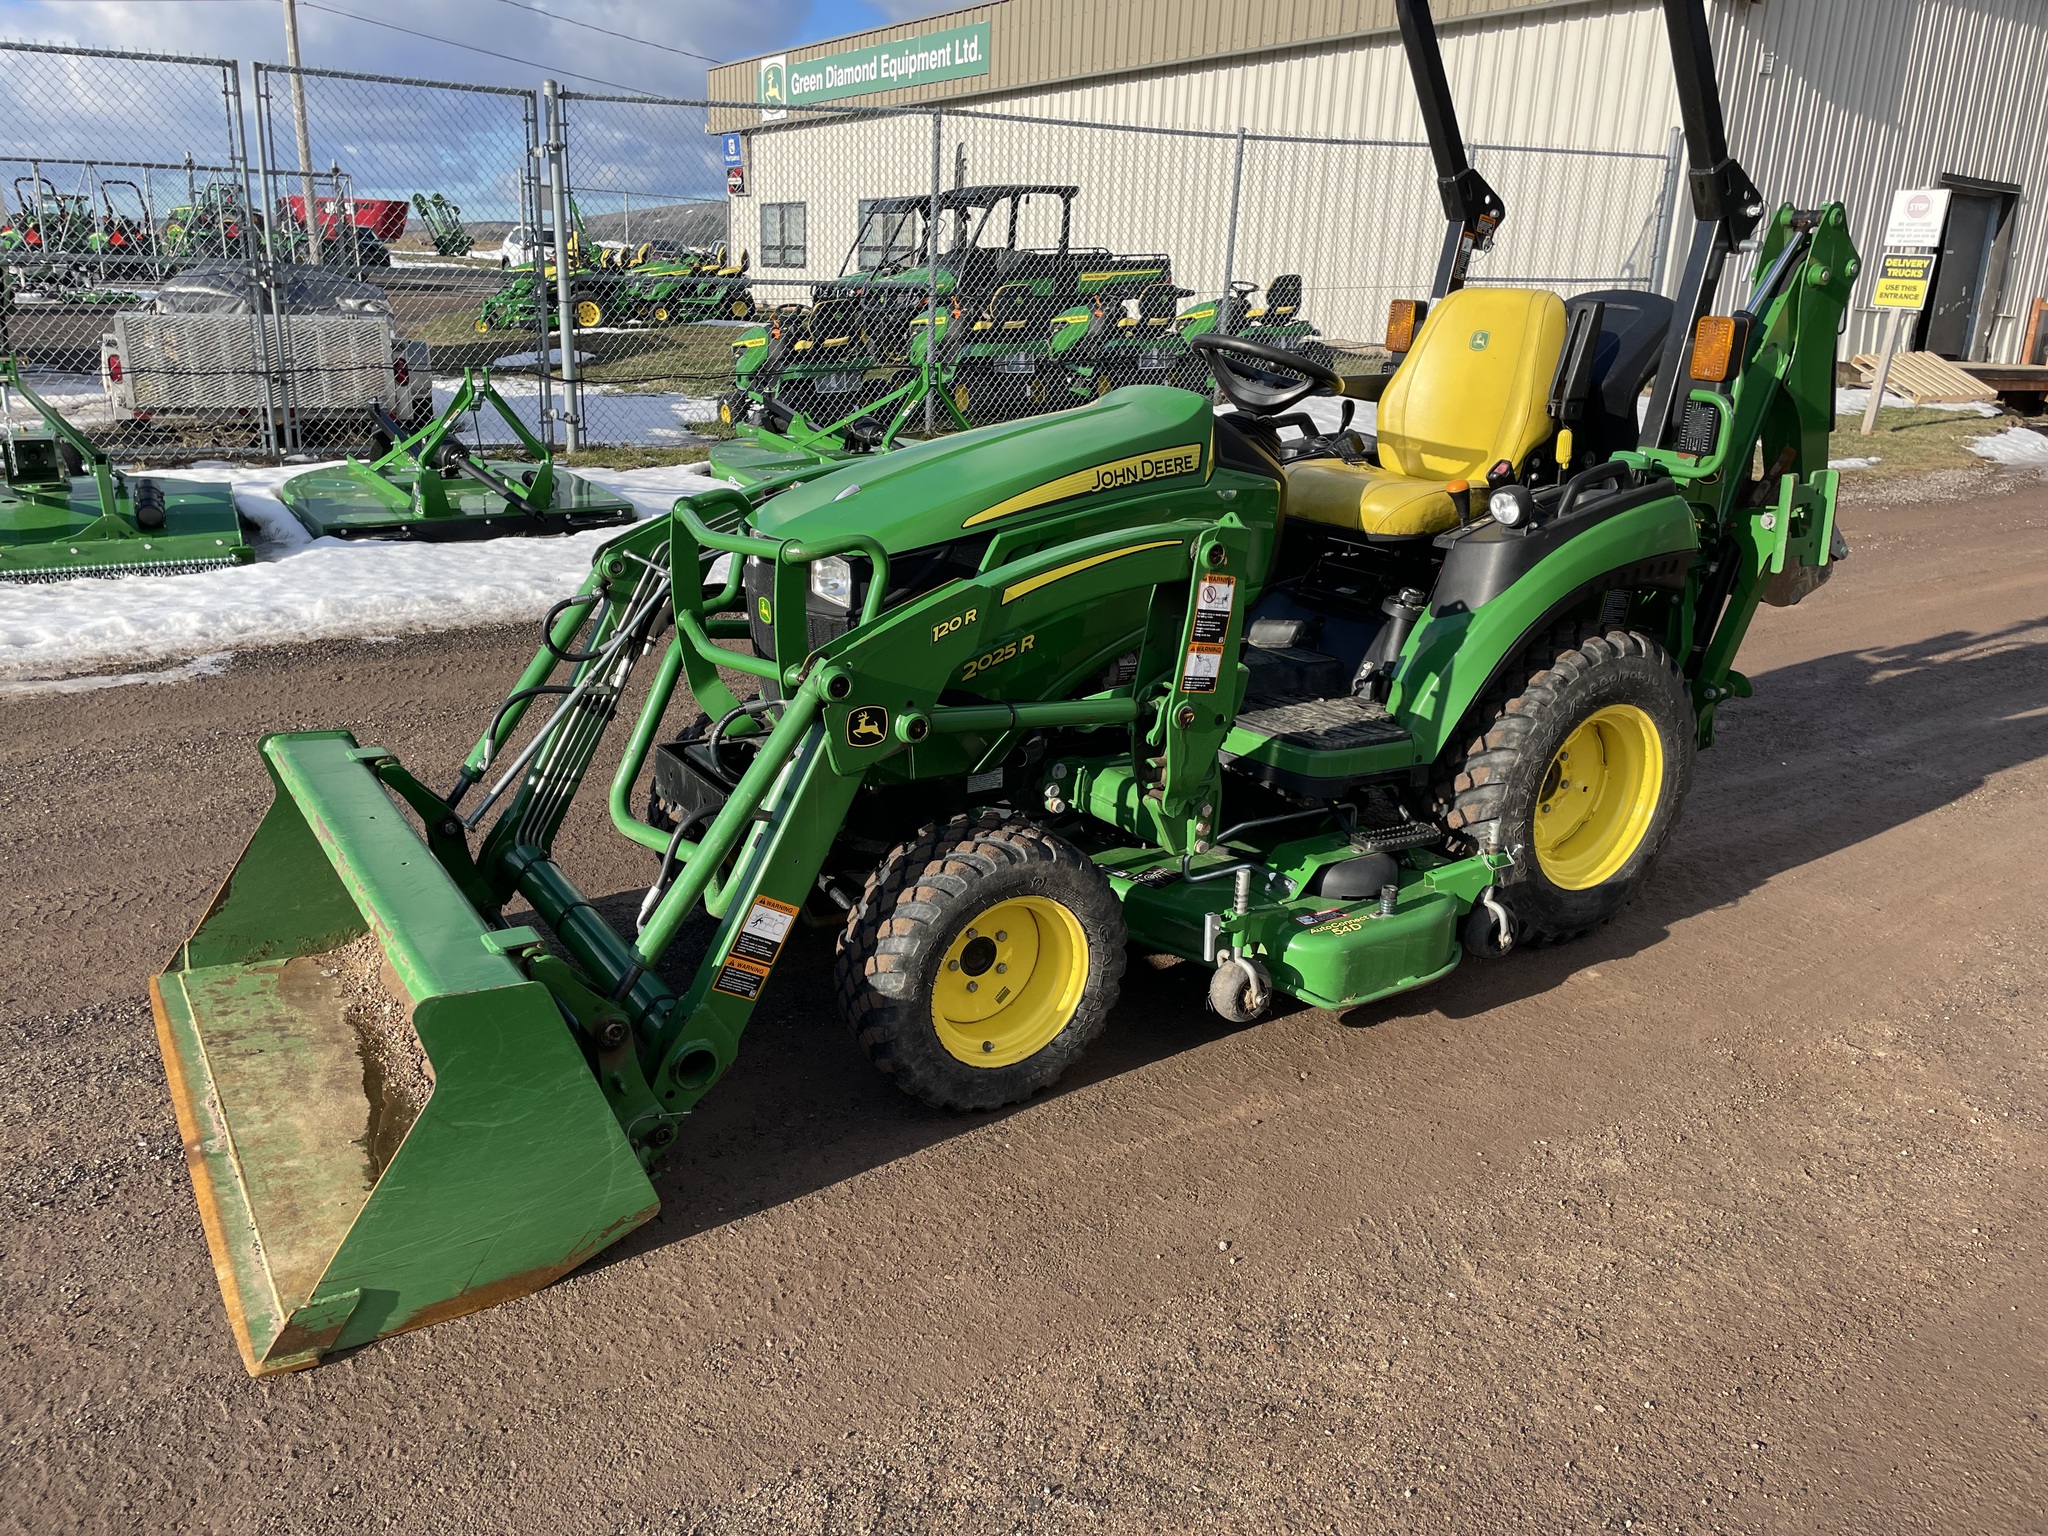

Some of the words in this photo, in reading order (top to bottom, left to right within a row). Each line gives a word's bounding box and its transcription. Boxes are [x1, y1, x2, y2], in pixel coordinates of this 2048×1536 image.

[791, 73, 823, 95] Green
[826, 56, 877, 89] Diamond
[881, 43, 951, 82] Equipment
[955, 34, 982, 65] Ltd.
[1909, 203, 1929, 211] STOP
[1885, 258, 1930, 268] DELIVERY
[1887, 268, 1924, 278] TRUCKS
[1879, 292, 1920, 300] ENTRANCE
[1091, 465, 1138, 490] JOHN
[1141, 455, 1194, 478] DEERE
[932, 616, 962, 642] 120
[964, 608, 977, 625] R
[1197, 646, 1222, 654] WARNING
[961, 641, 1017, 682] 2025
[1020, 633, 1035, 653] R
[767, 900, 794, 914] WARNING
[1310, 915, 1370, 934] AutoConnect
[1331, 923, 1362, 936] 54D
[737, 962, 764, 975] WARNING
